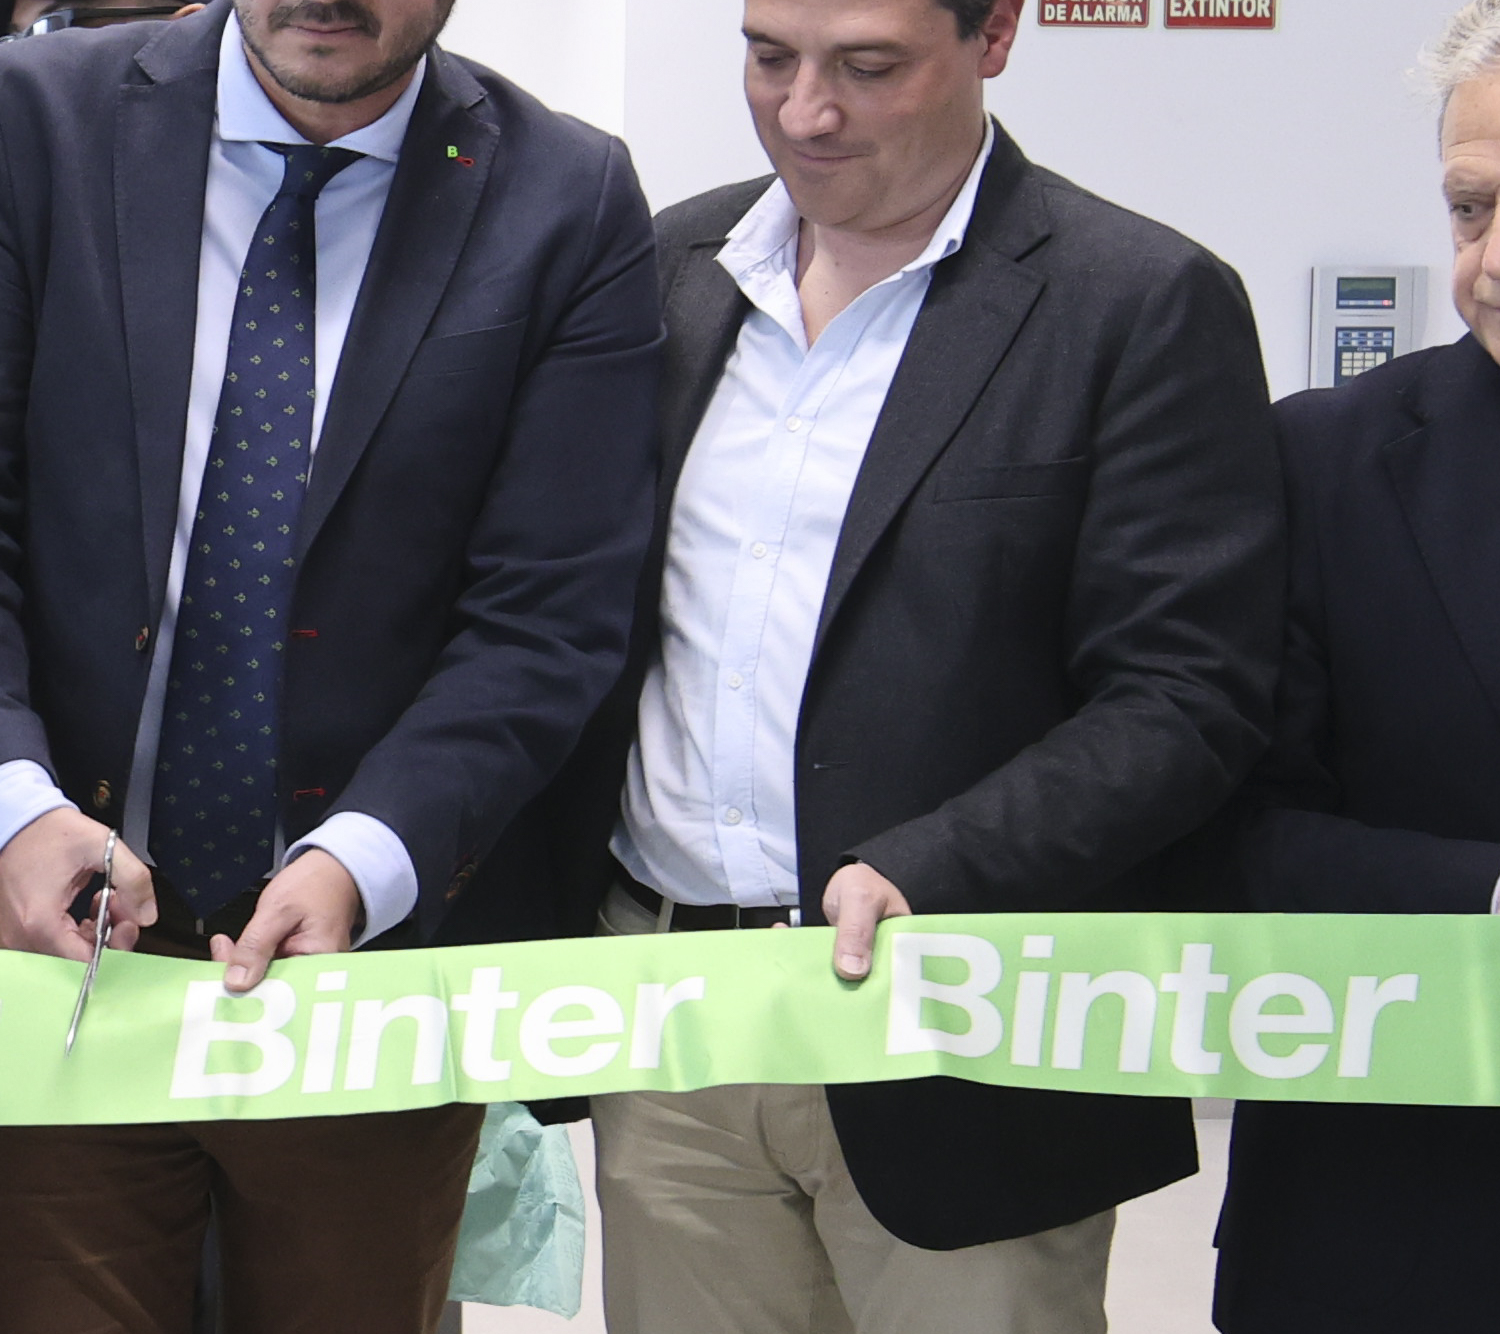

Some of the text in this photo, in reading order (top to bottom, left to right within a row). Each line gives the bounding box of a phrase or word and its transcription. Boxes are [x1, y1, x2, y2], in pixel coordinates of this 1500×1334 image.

[1044, 3, 1143, 23] DE ALARMA
[168, 966, 706, 1099] Binter
[885, 931, 1420, 1079] Binter
